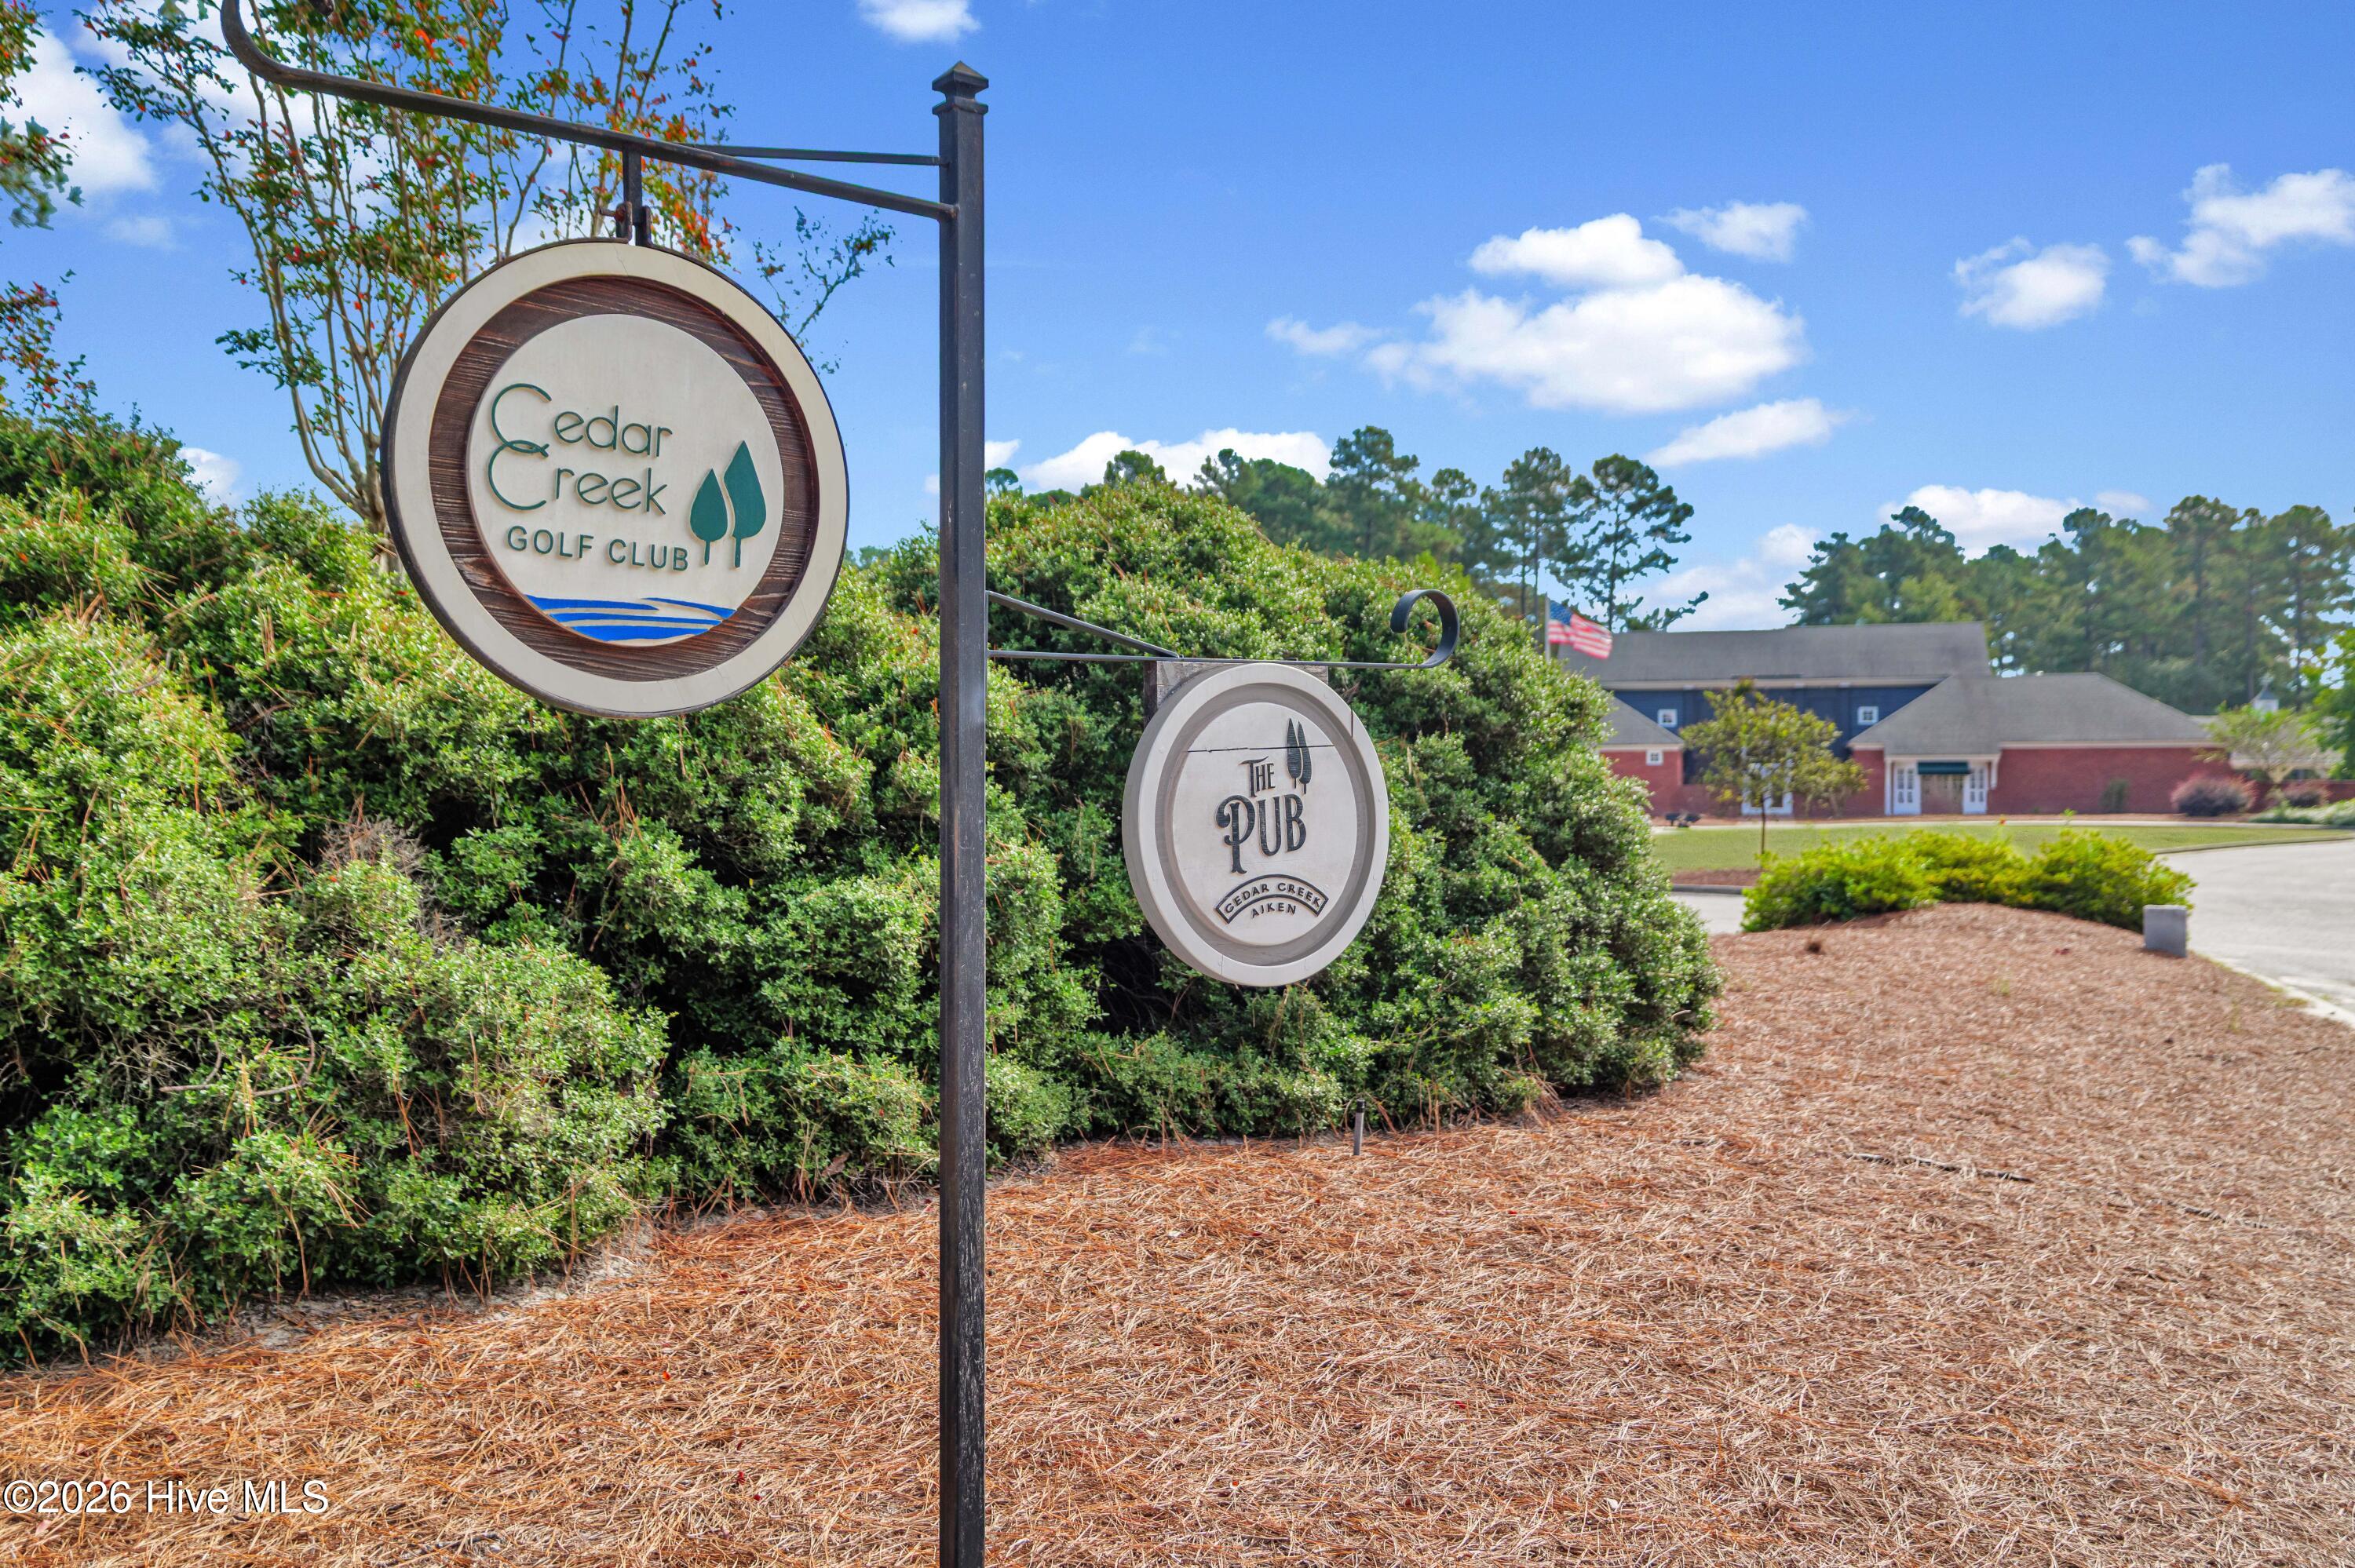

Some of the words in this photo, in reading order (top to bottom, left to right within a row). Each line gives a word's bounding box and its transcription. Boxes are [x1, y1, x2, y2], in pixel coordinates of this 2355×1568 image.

[491, 382, 674, 458] Cedar
[487, 439, 668, 515] Creek
[507, 525, 595, 559] GOLF
[608, 538, 689, 571] CLUB
[1239, 756, 1276, 797] THE
[1216, 793, 1307, 874] PUB
[1225, 883, 1270, 914] CEDAR
[1277, 882, 1322, 908] CREEK
[1251, 902, 1297, 919] AIKEN
